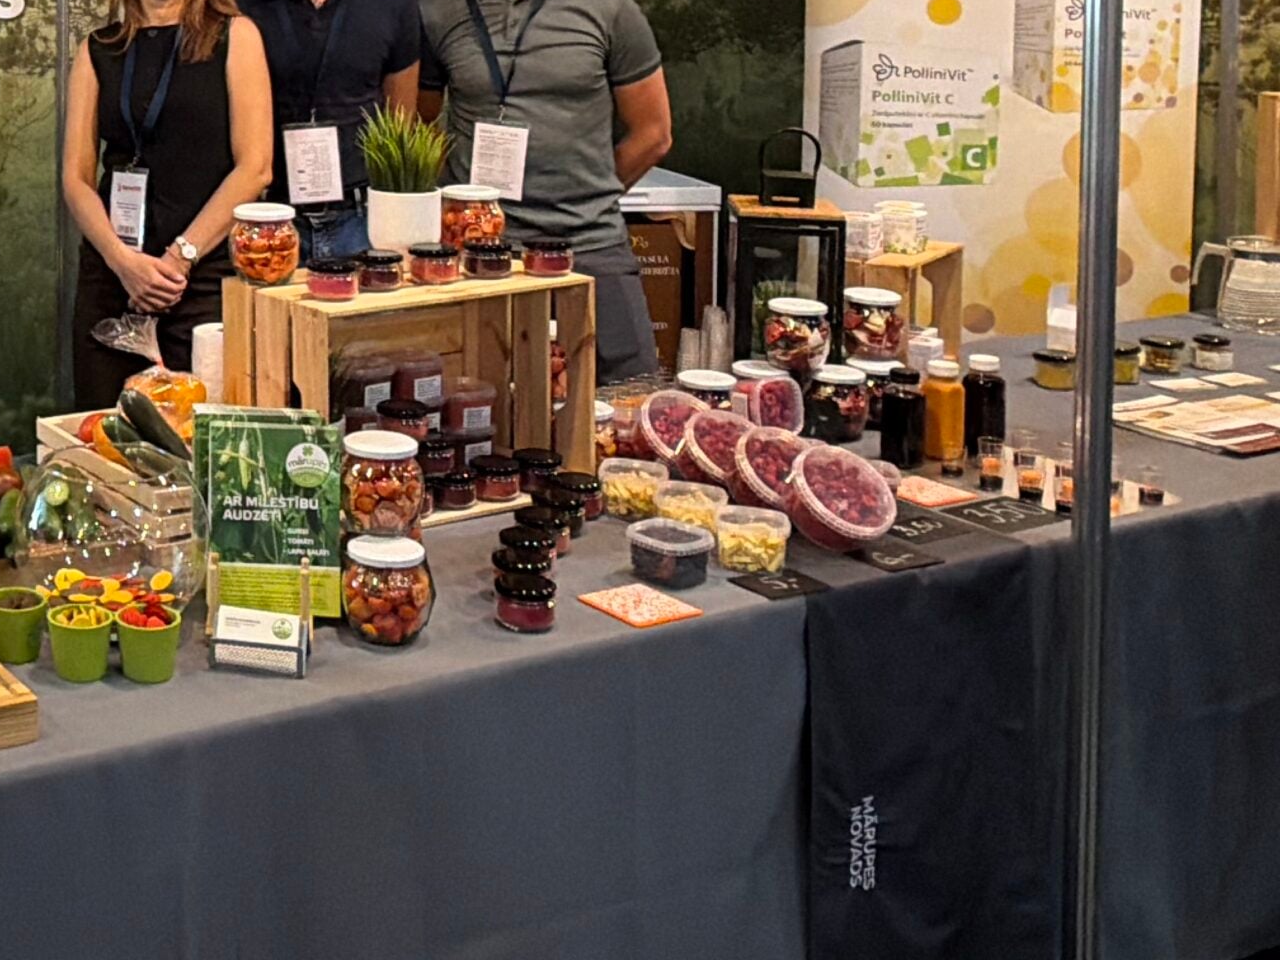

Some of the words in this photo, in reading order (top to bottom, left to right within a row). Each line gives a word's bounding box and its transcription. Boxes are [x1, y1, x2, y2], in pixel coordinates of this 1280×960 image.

[871, 89, 941, 105] PolliniVit
[945, 93, 955, 105] C
[966, 147, 982, 168] C
[222, 495, 242, 507] AR
[849, 806, 863, 889] NOVADS
[862, 795, 878, 891] MĀRUPES
